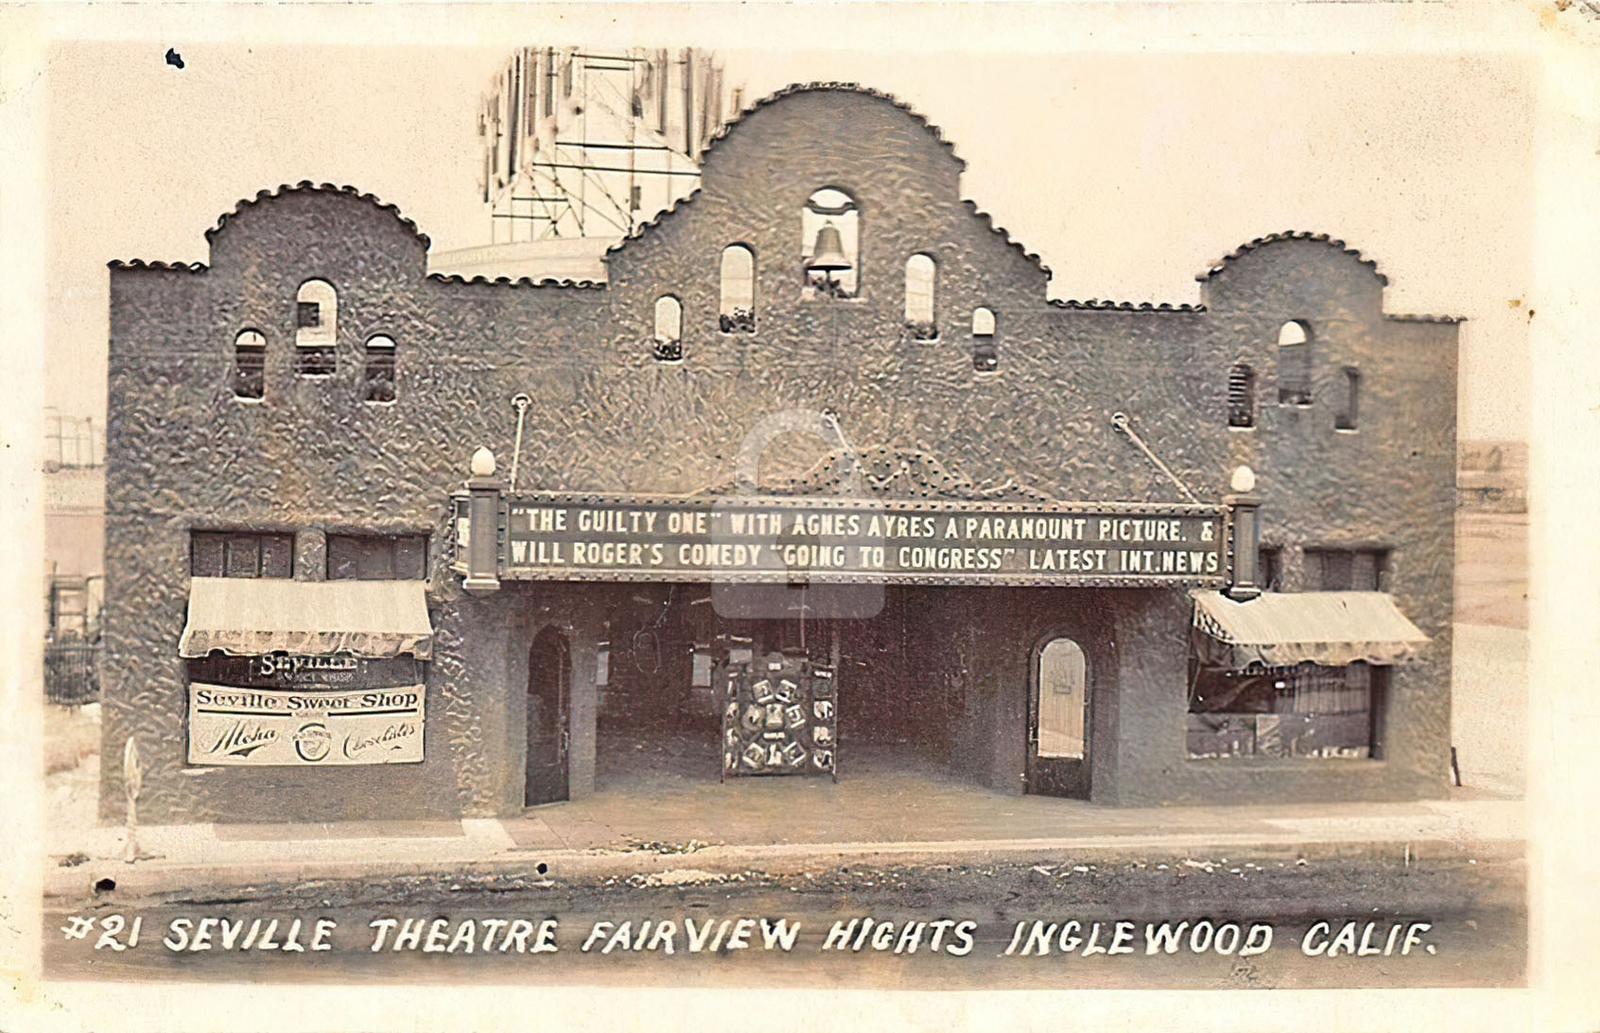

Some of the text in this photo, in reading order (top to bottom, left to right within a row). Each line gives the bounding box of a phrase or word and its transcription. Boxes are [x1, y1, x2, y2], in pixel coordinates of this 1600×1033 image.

[578, 510, 656, 533] GUILTY
[730, 512, 782, 535] WITH
[791, 513, 860, 536] AGNES
[867, 515, 935, 538] AYRES
[945, 517, 958, 539] A
[965, 517, 1087, 540] PARAMOUNT
[1201, 521, 1213, 542] &
[511, 541, 565, 564] WILL
[573, 543, 663, 565] ROGER'S
[679, 544, 761, 566] COMEDY
[859, 546, 884, 568] TO
[1029, 549, 1106, 571] LATEST
[196, 690, 278, 710] Seville
[361, 693, 418, 708] Shop
